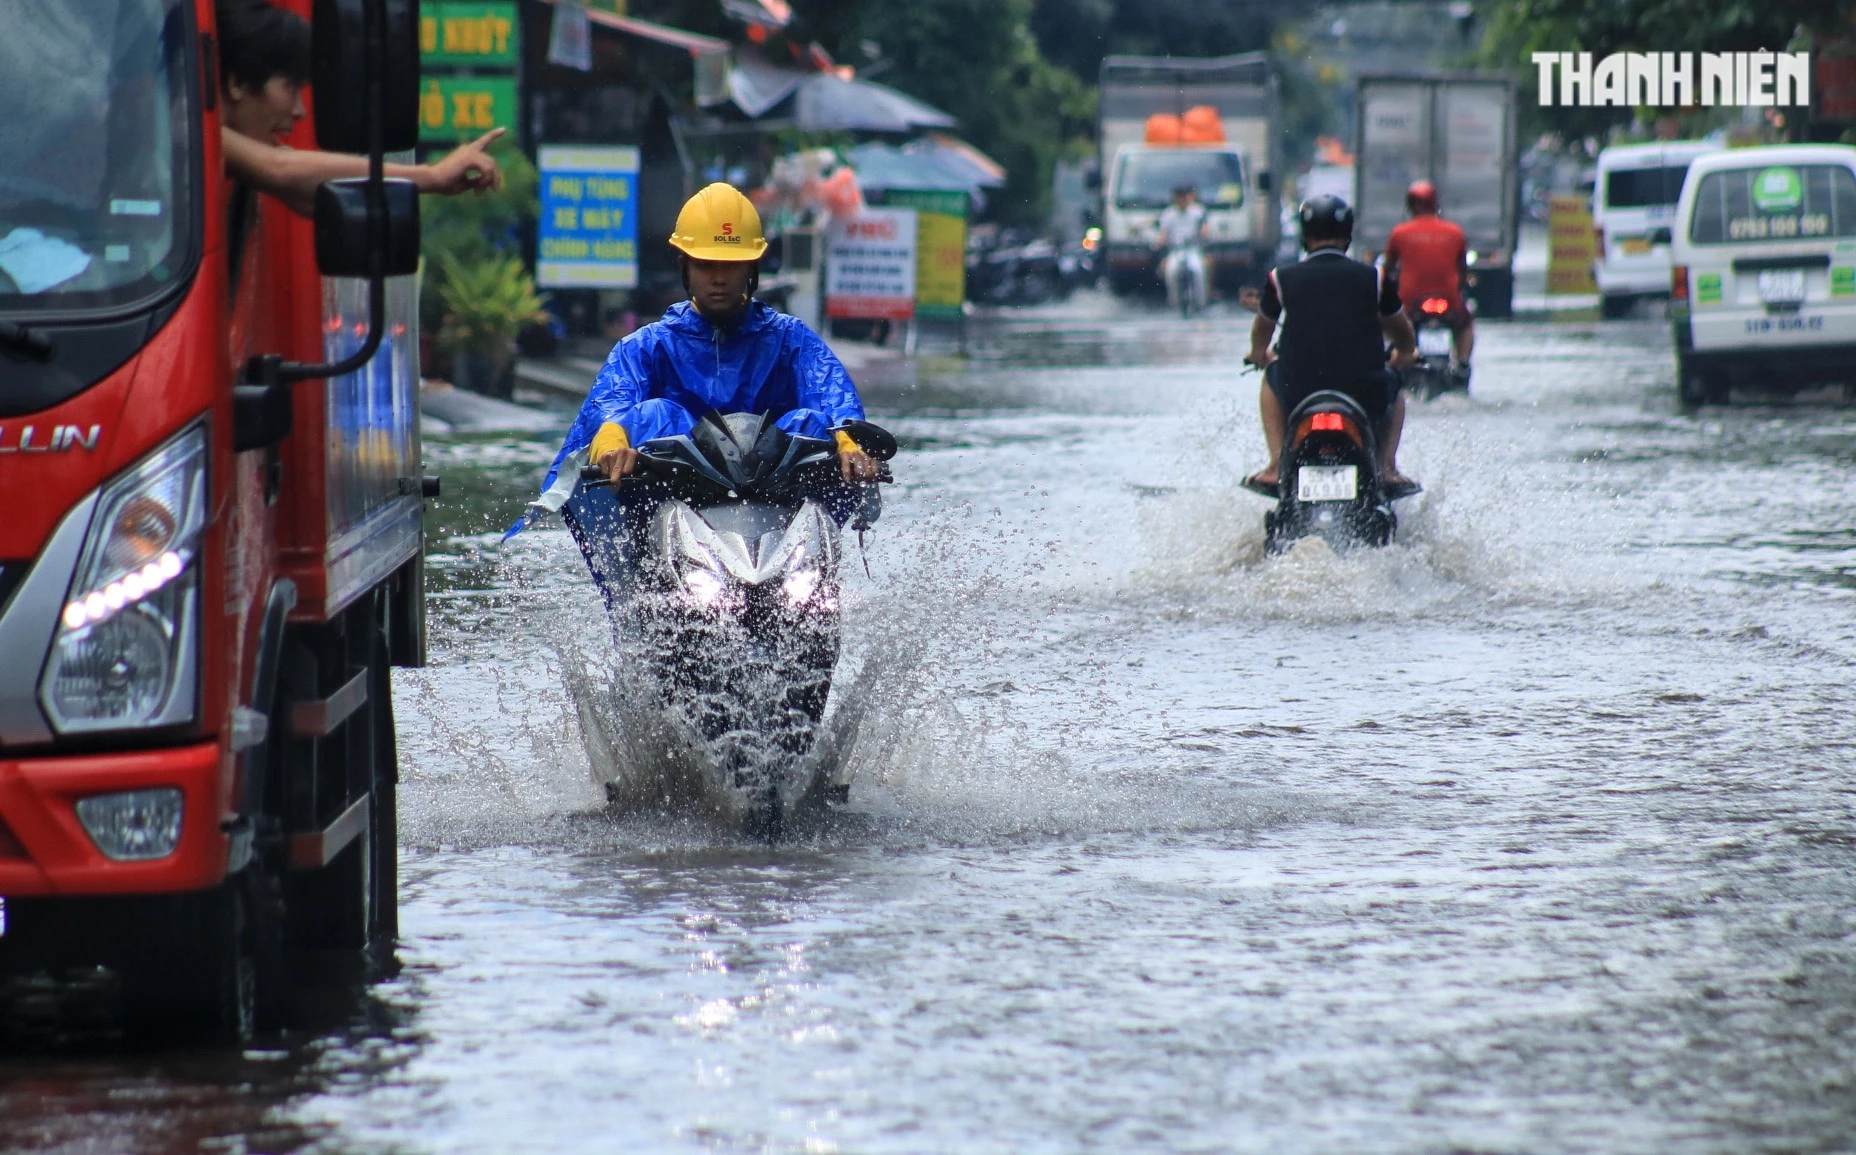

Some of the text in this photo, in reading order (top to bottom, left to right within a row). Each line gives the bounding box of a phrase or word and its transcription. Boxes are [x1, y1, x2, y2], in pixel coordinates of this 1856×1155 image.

[452, 91, 494, 128] XE
[554, 203, 624, 231] XE MÁY
